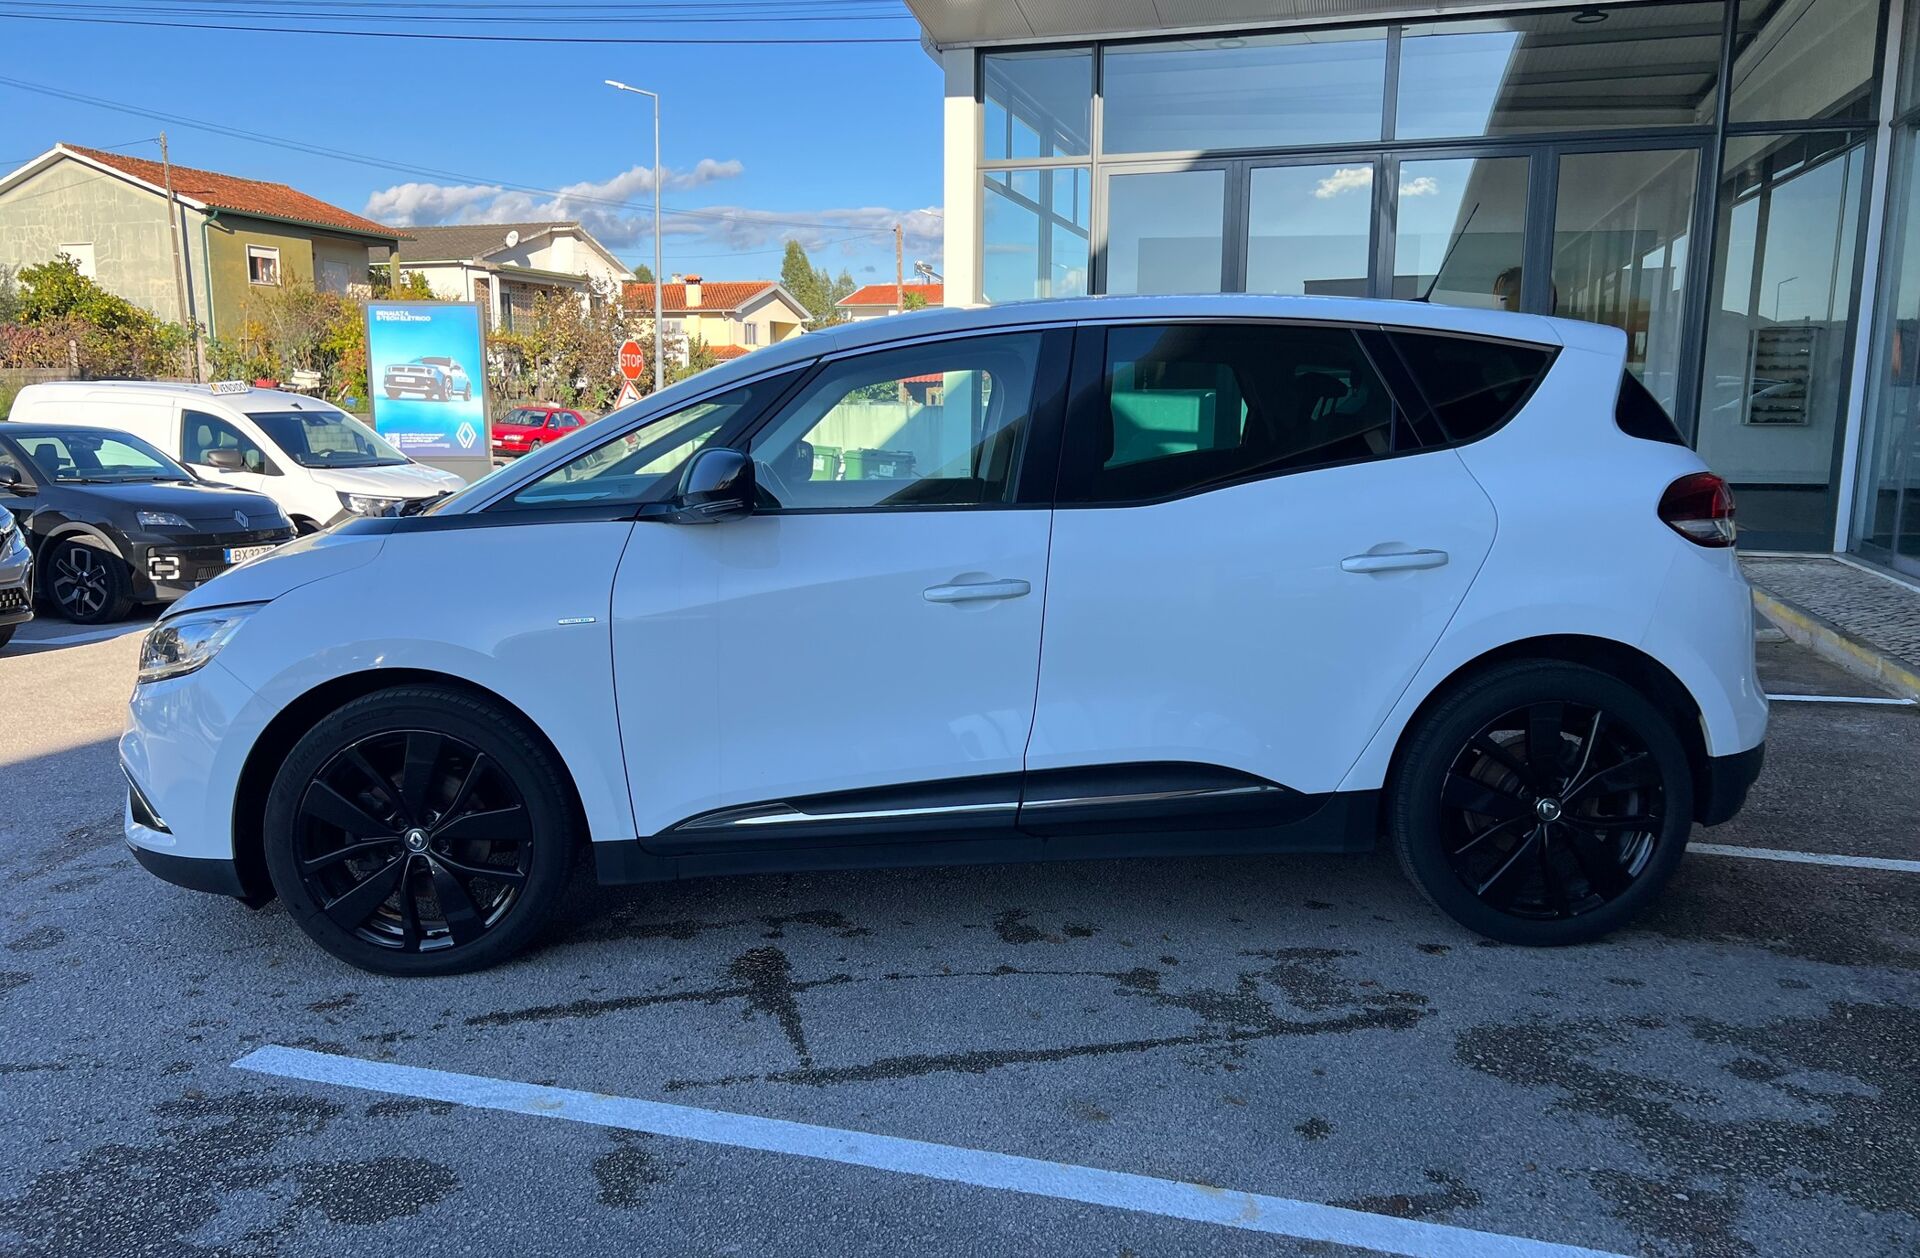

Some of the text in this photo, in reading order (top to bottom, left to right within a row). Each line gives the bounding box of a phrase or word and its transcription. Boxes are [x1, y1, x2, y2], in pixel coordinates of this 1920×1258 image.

[621, 353, 642, 368] STOP
[220, 382, 247, 392] VENDIDO
[234, 549, 248, 561] BX
